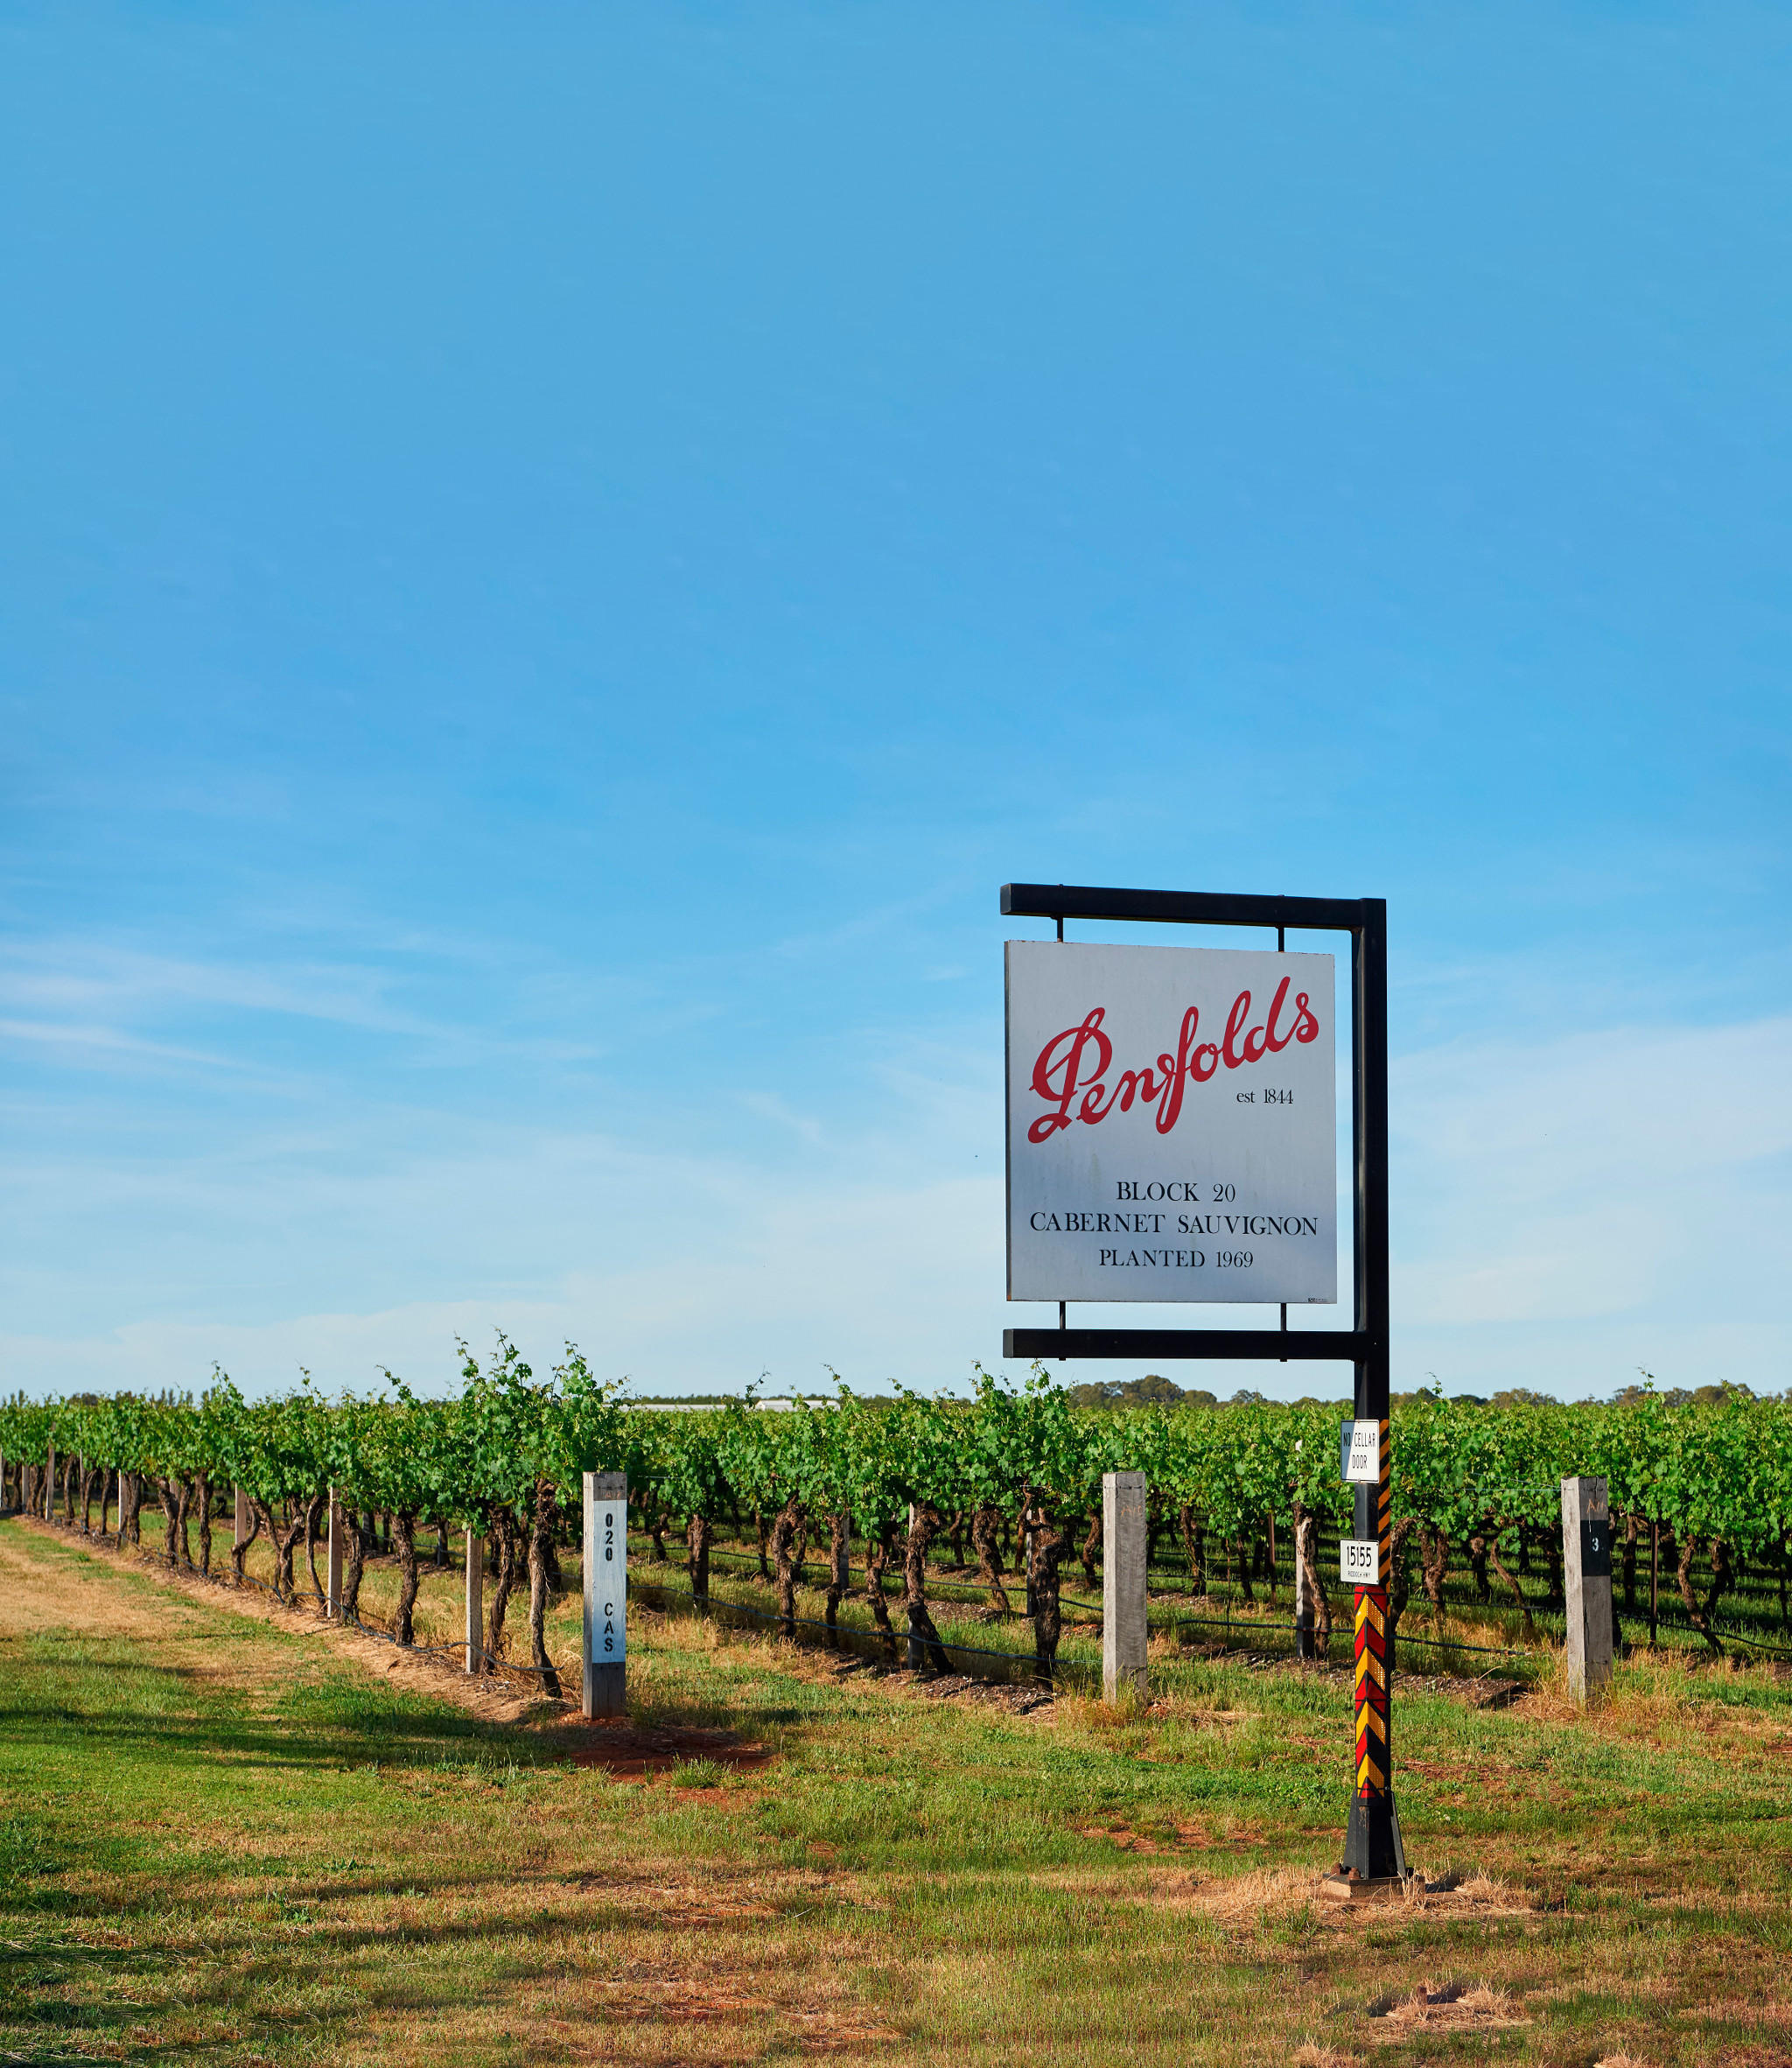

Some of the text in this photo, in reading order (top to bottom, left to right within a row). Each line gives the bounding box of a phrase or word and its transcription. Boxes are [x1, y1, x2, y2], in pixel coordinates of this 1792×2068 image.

[1028, 976, 1320, 1144] Penfolds
[1236, 1089, 1294, 1104] est 1844
[1116, 1181, 1236, 1202] BLOCK 20
[1030, 1211, 1319, 1236] CABERNET SAUVIGNON
[1099, 1249, 1254, 1268] PLANTED 1969
[1343, 1432, 1376, 1448] NO CELLAR
[1352, 1455, 1368, 1469] DOOR
[1592, 1537, 1600, 1552] 3
[1347, 1546, 1372, 1567] 15155
[604, 1512, 614, 1652] 020 CAS
